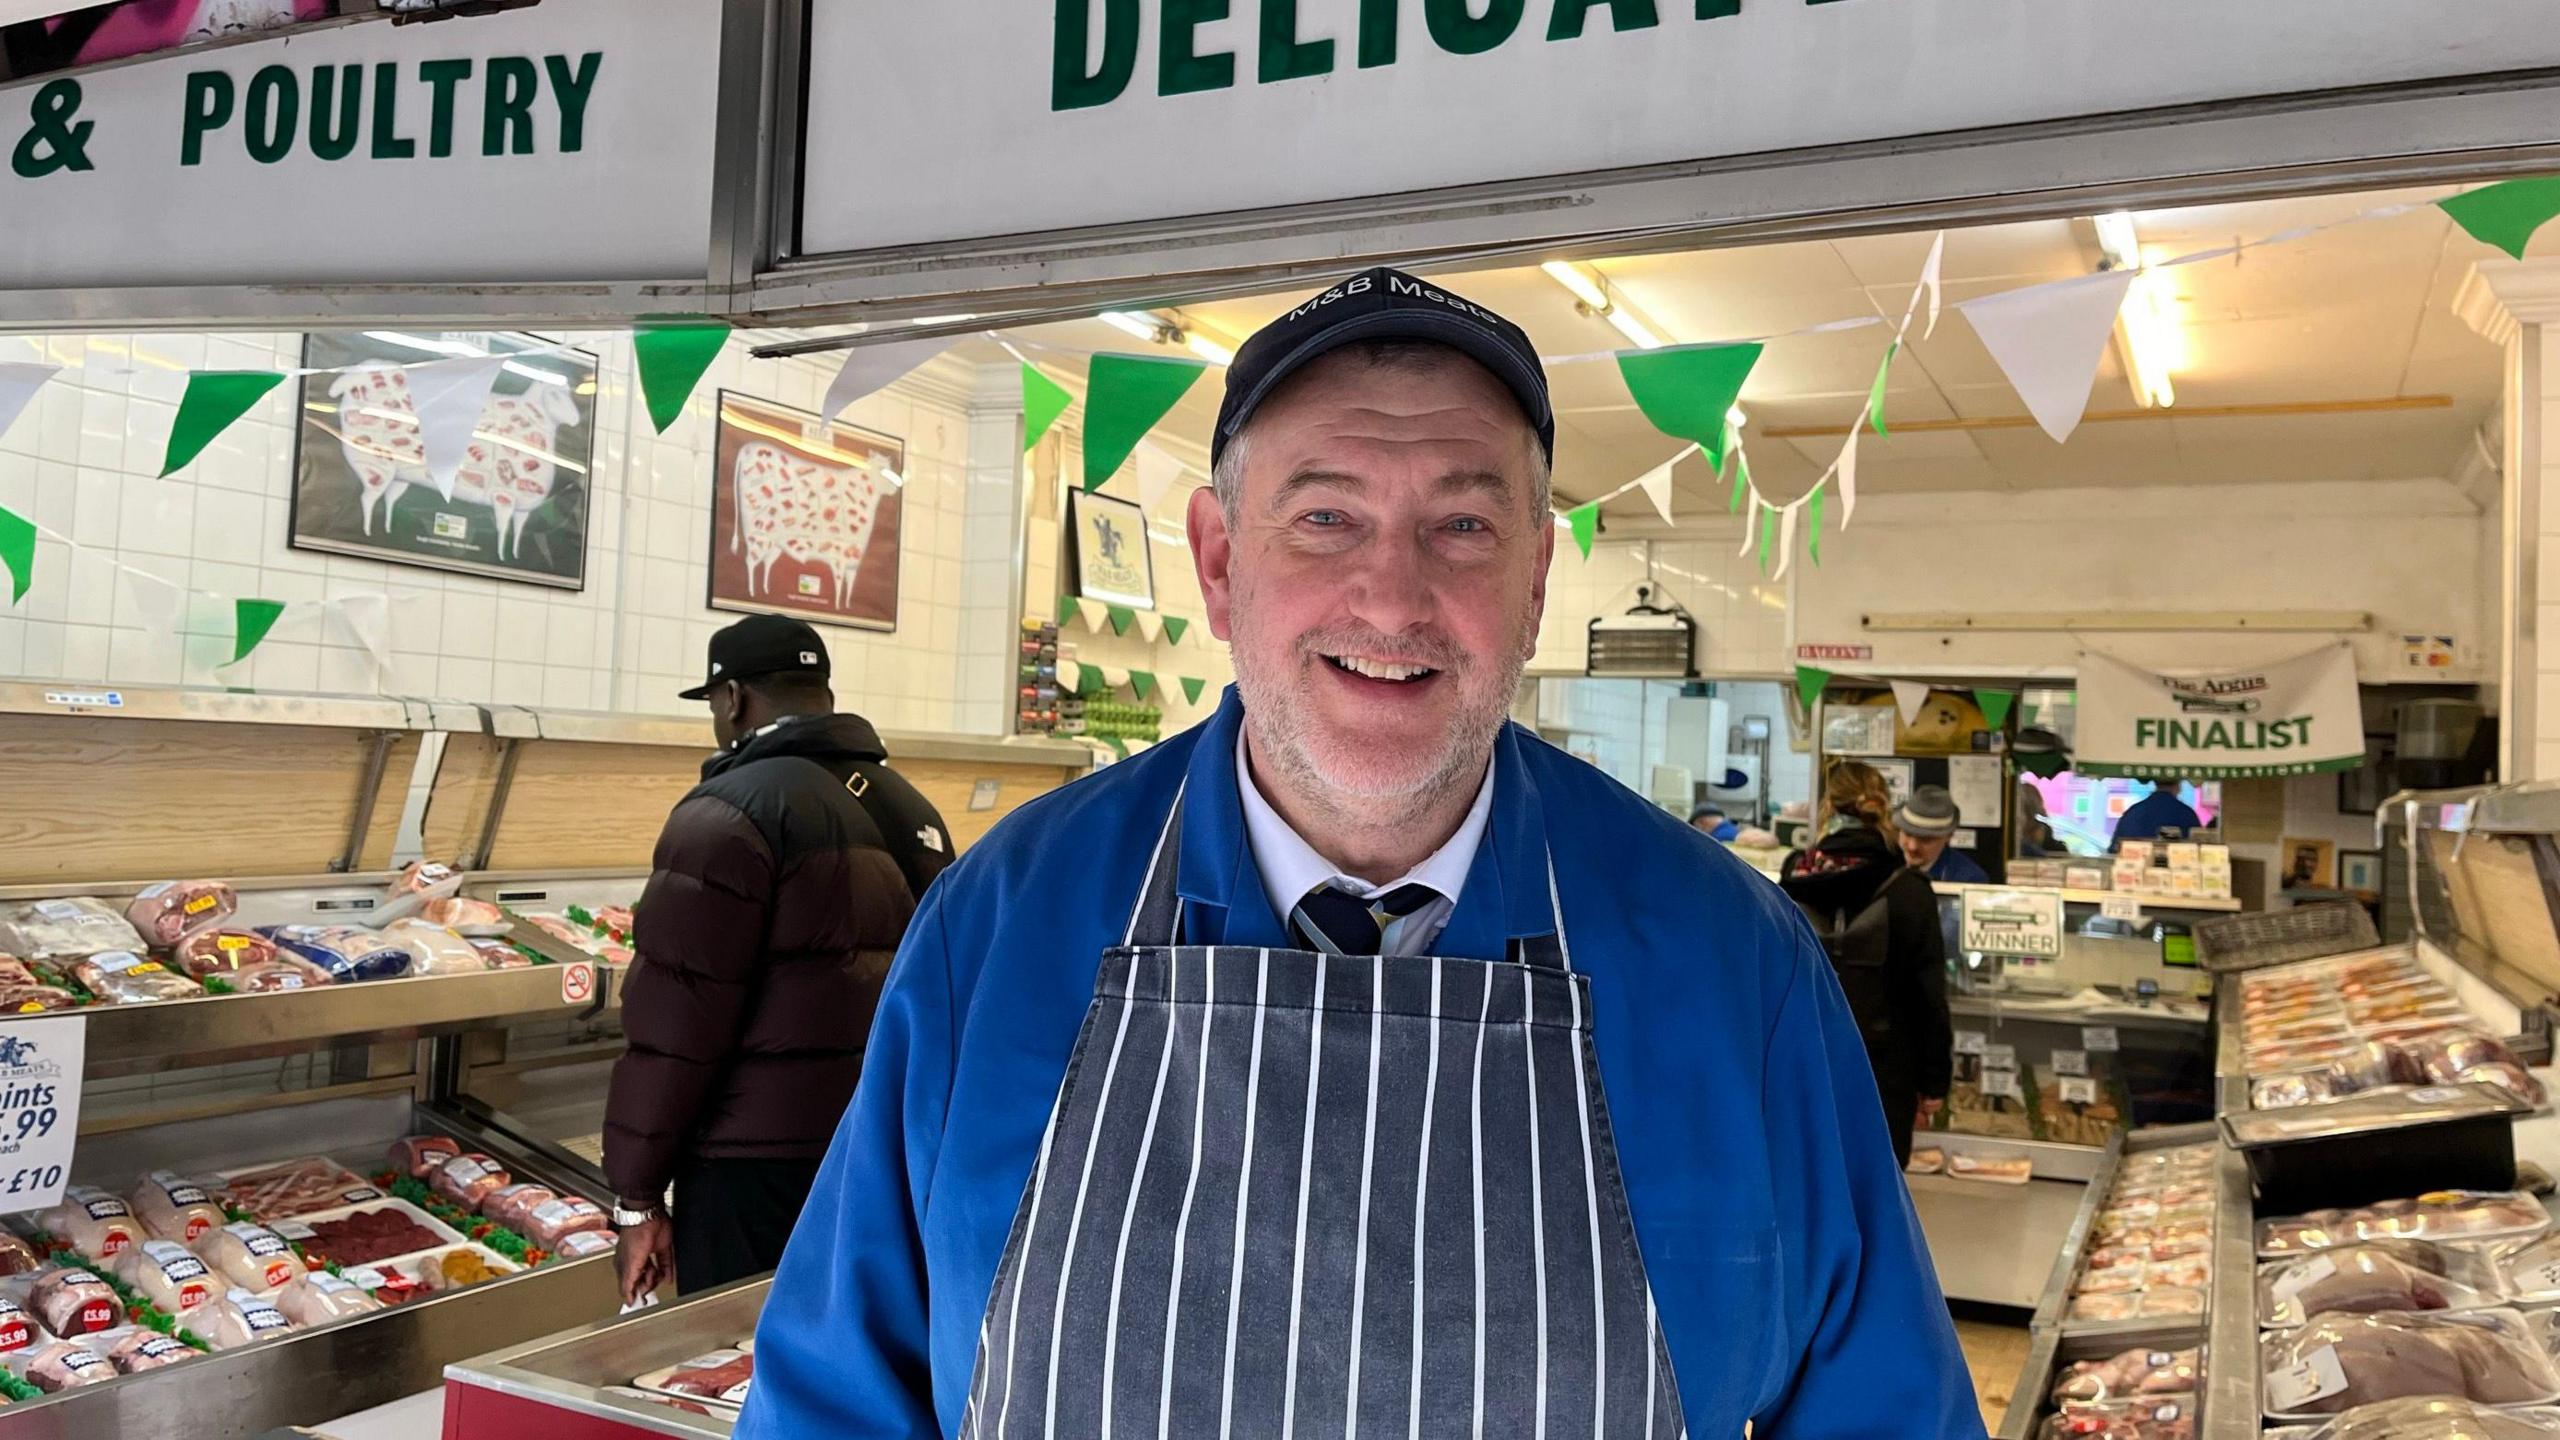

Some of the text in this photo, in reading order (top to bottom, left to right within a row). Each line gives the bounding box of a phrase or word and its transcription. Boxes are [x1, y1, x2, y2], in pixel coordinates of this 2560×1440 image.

[12, 52, 603, 178] & POULTRY
[1289, 276, 1498, 324] M&B Meats
[2202, 675, 2268, 695] Argus
[2136, 715, 2314, 749] FINALIST
[2122, 764, 2317, 778] CONGRATULATIONS
[1968, 931, 2054, 951] WINNER
[0, 1082, 55, 1110] ints
[0, 1142, 21, 1154] ach
[7, 1165, 62, 1194] £10
[83, 1308, 112, 1321] £5.99
[0, 1328, 27, 1347] £5.99
